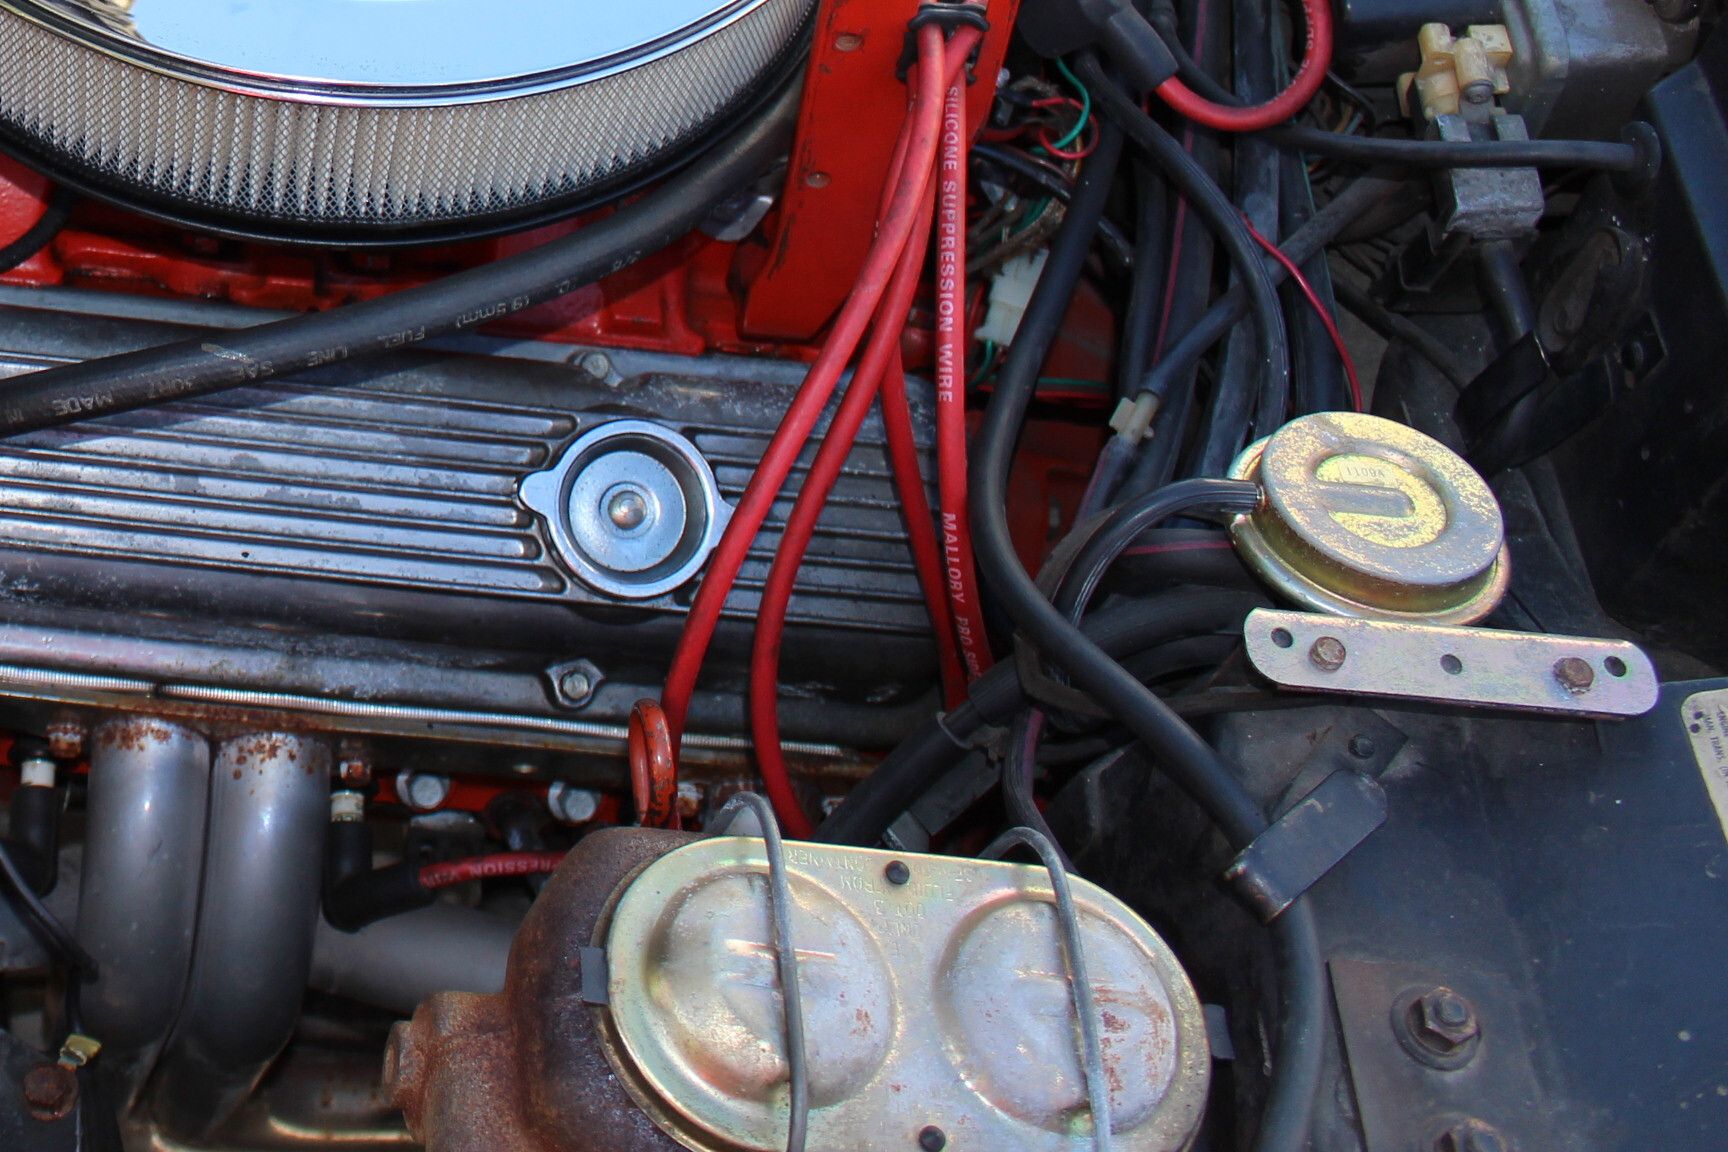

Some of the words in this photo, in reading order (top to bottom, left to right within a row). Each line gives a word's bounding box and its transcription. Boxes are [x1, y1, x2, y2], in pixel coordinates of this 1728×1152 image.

[943, 84, 959, 171] SILICONE
[936, 179, 958, 334] SUPPRESSION
[52, 392, 114, 417] MADE
[936, 341, 954, 405] WIRE
[943, 511, 965, 604] MALLORY
